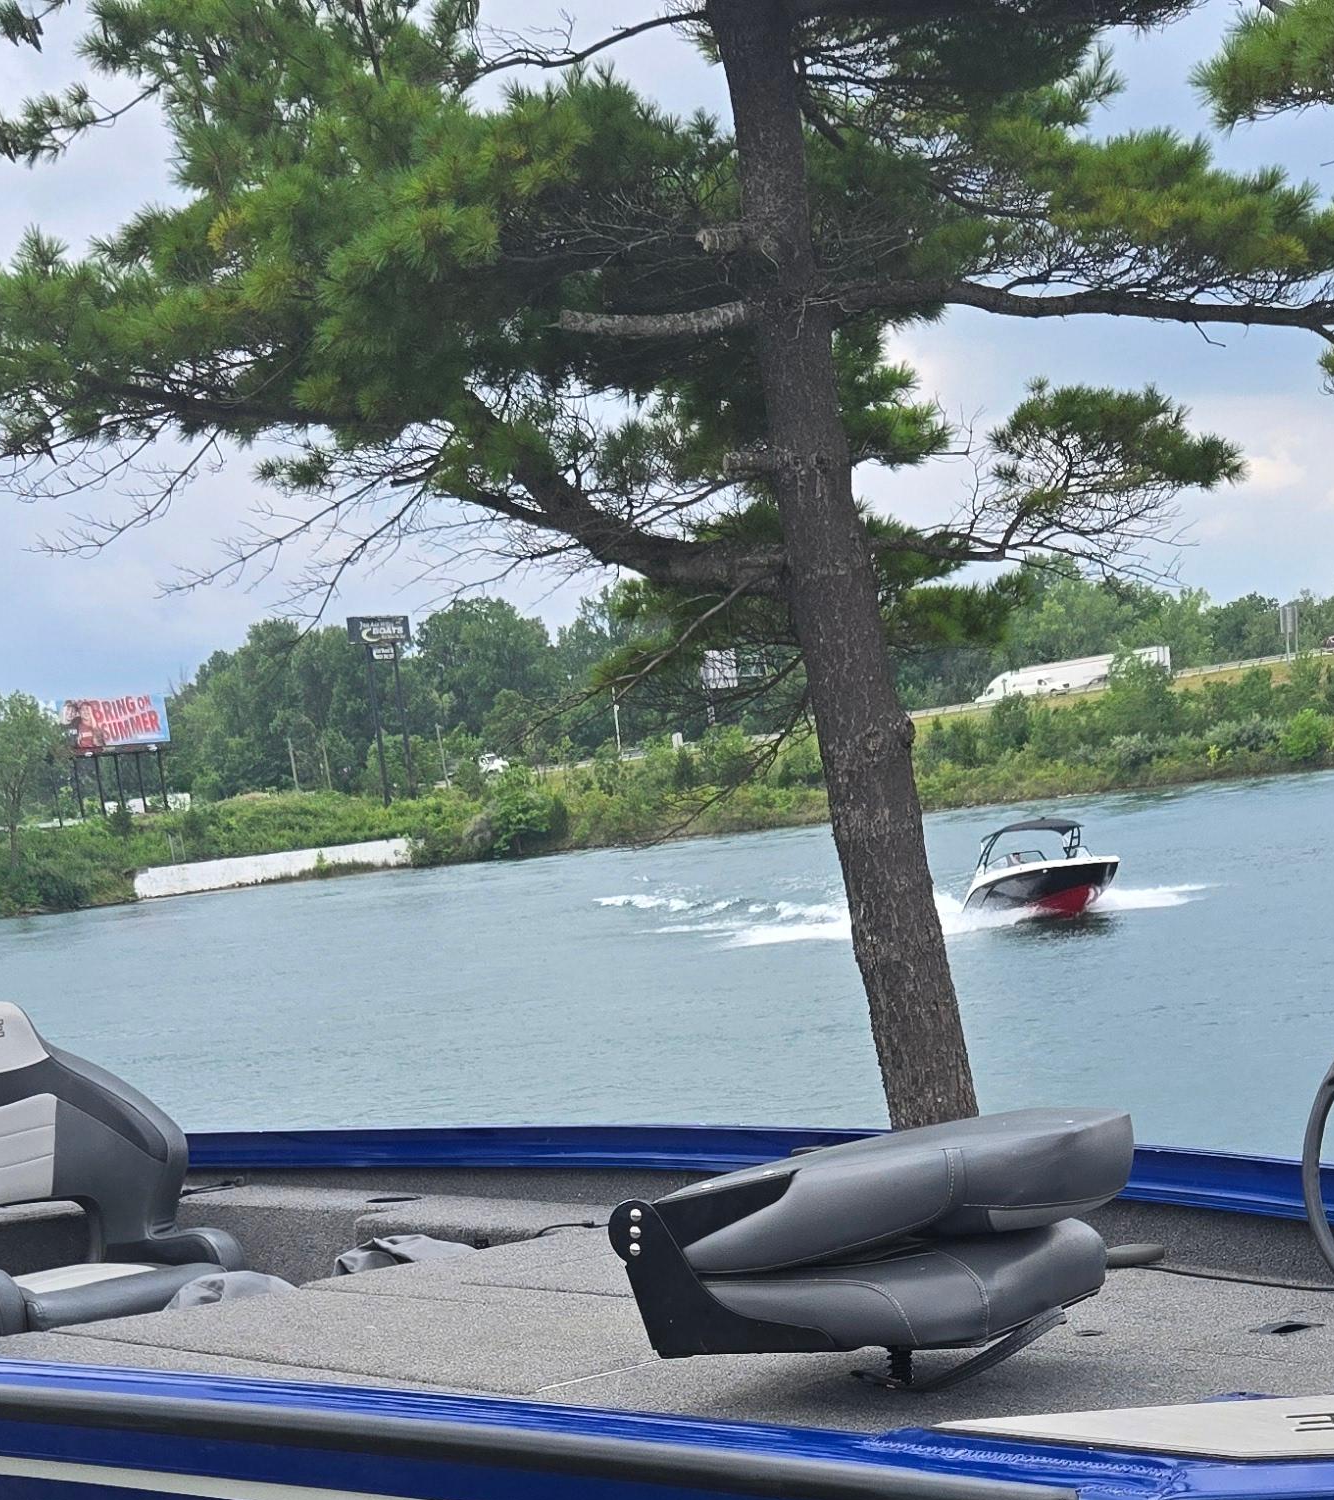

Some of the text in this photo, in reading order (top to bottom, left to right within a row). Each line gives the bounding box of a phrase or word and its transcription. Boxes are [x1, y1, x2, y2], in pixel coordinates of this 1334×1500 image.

[91, 695, 152, 722] BRING ON
[100, 710, 161, 741] SUMMER
